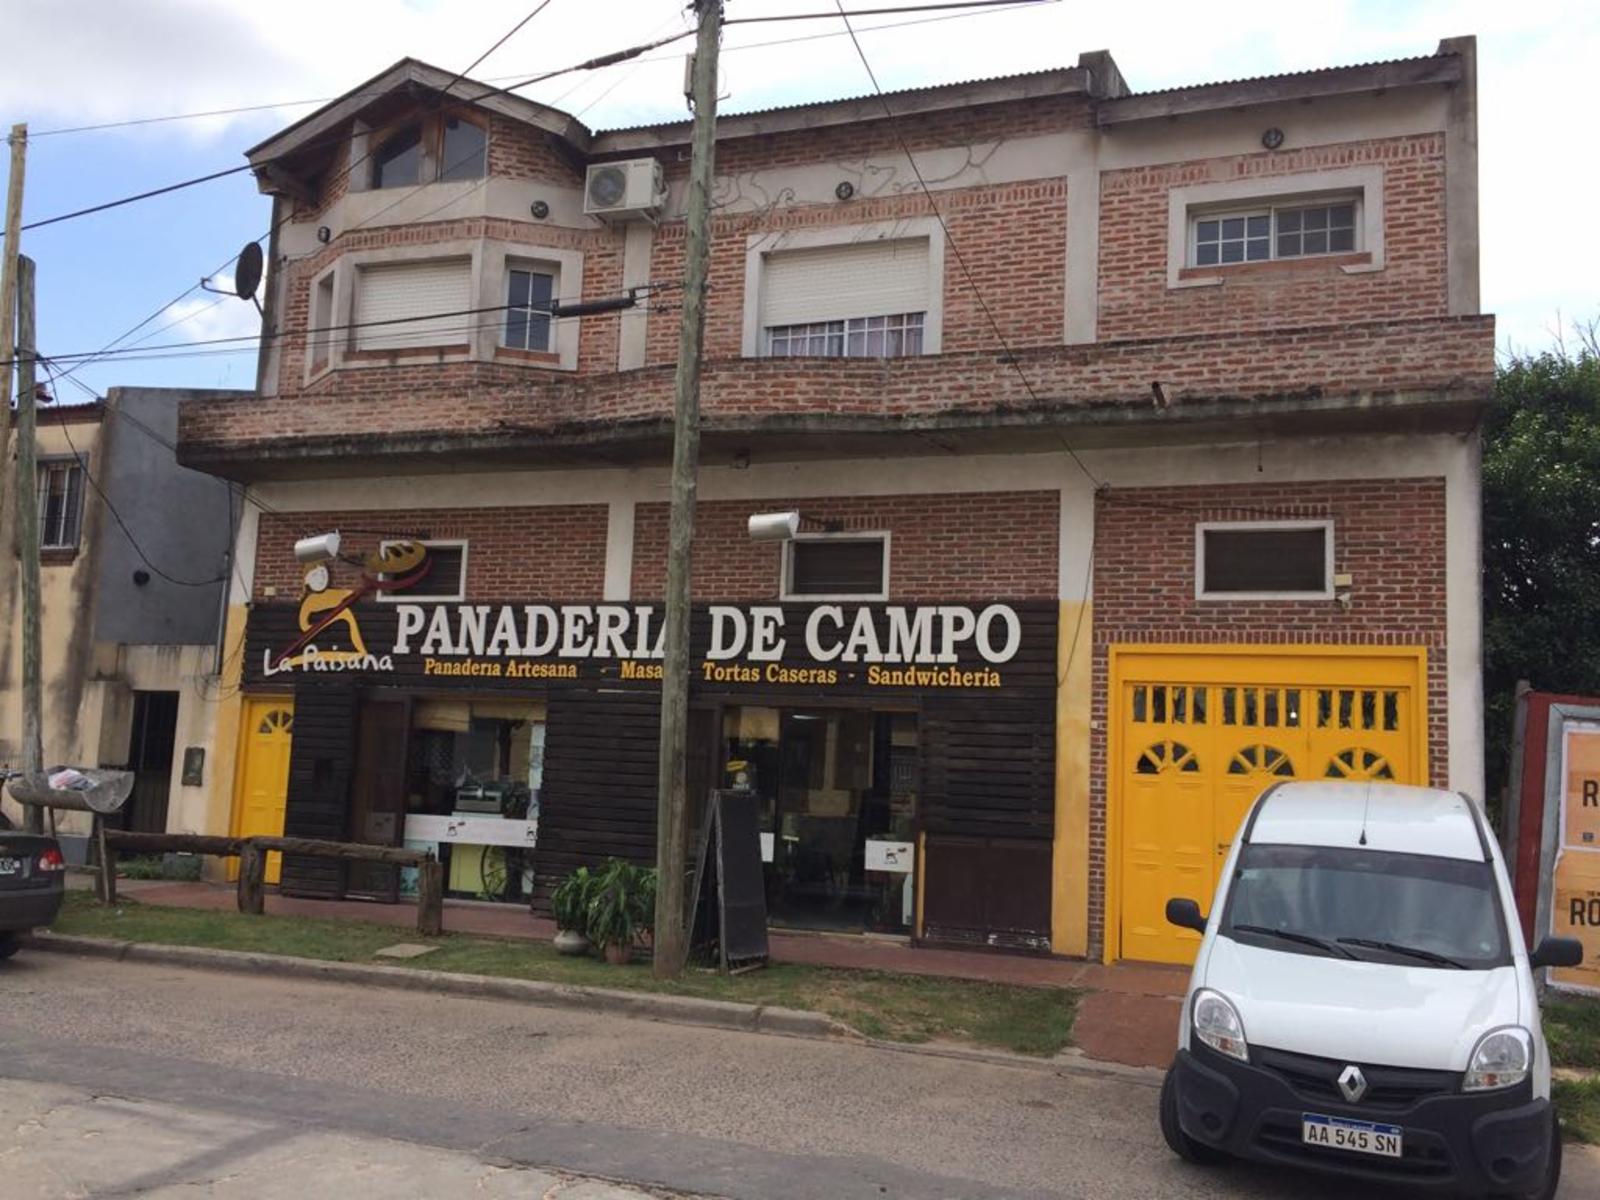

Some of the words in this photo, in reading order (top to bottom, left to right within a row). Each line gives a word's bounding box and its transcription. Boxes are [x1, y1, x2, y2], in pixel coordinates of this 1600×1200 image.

[706, 605, 787, 660] DE
[805, 604, 1021, 663] CAMPO
[263, 647, 293, 676] La
[302, 643, 394, 672] Paisana
[505, 659, 577, 678] Artesana
[702, 662, 761, 682] Tortas
[765, 663, 837, 684] Caseras
[868, 665, 1001, 687] Sandwicheria
[1308, 1124, 1329, 1144] AA
[1335, 1129, 1368, 1149] 545
[1375, 1134, 1397, 1154] SN
